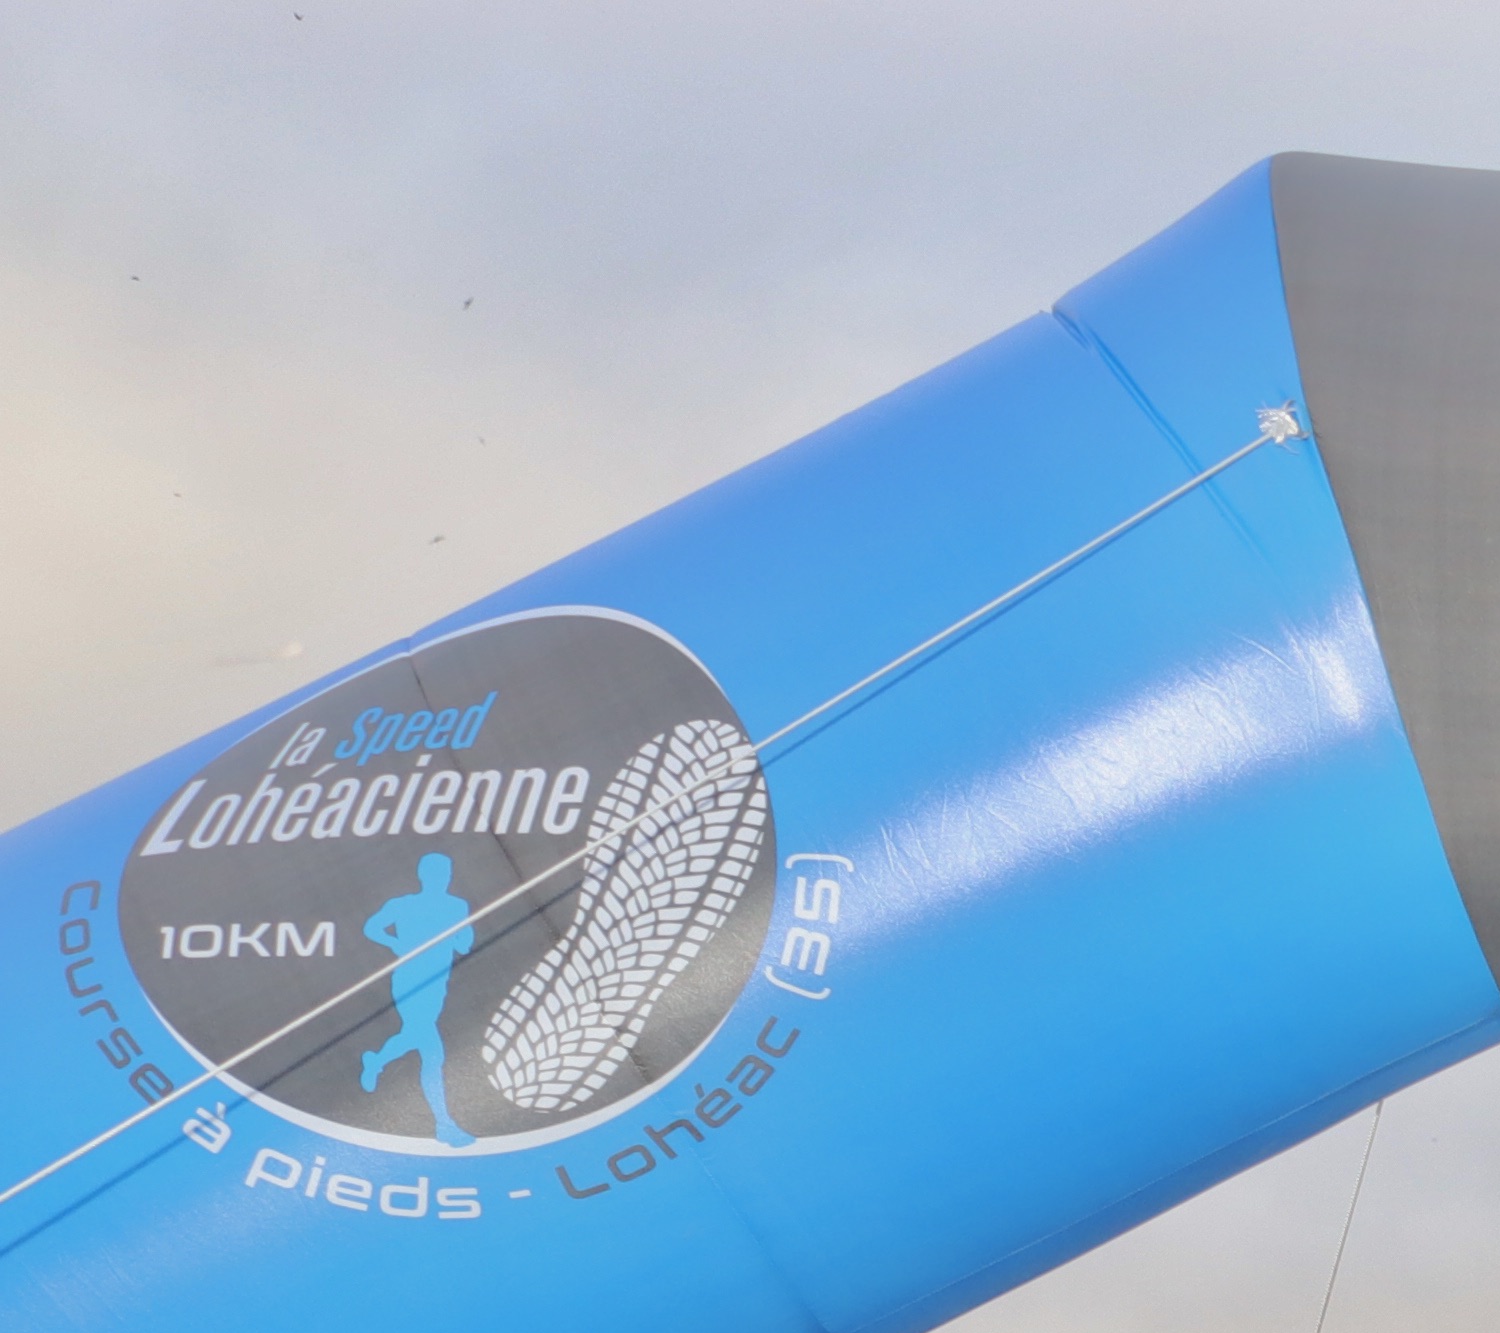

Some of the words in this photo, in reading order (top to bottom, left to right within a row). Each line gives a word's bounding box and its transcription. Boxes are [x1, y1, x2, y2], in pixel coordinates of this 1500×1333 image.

[271, 722, 329, 770] la
[334, 690, 498, 767] Speed
[139, 754, 591, 858] Lohéacienne
[160, 921, 337, 960] 10KM
[58, 879, 174, 1107] Course
[183, 1102, 231, 1155] à
[554, 1014, 802, 1201] Lohéac
[765, 852, 855, 1000] (35)
